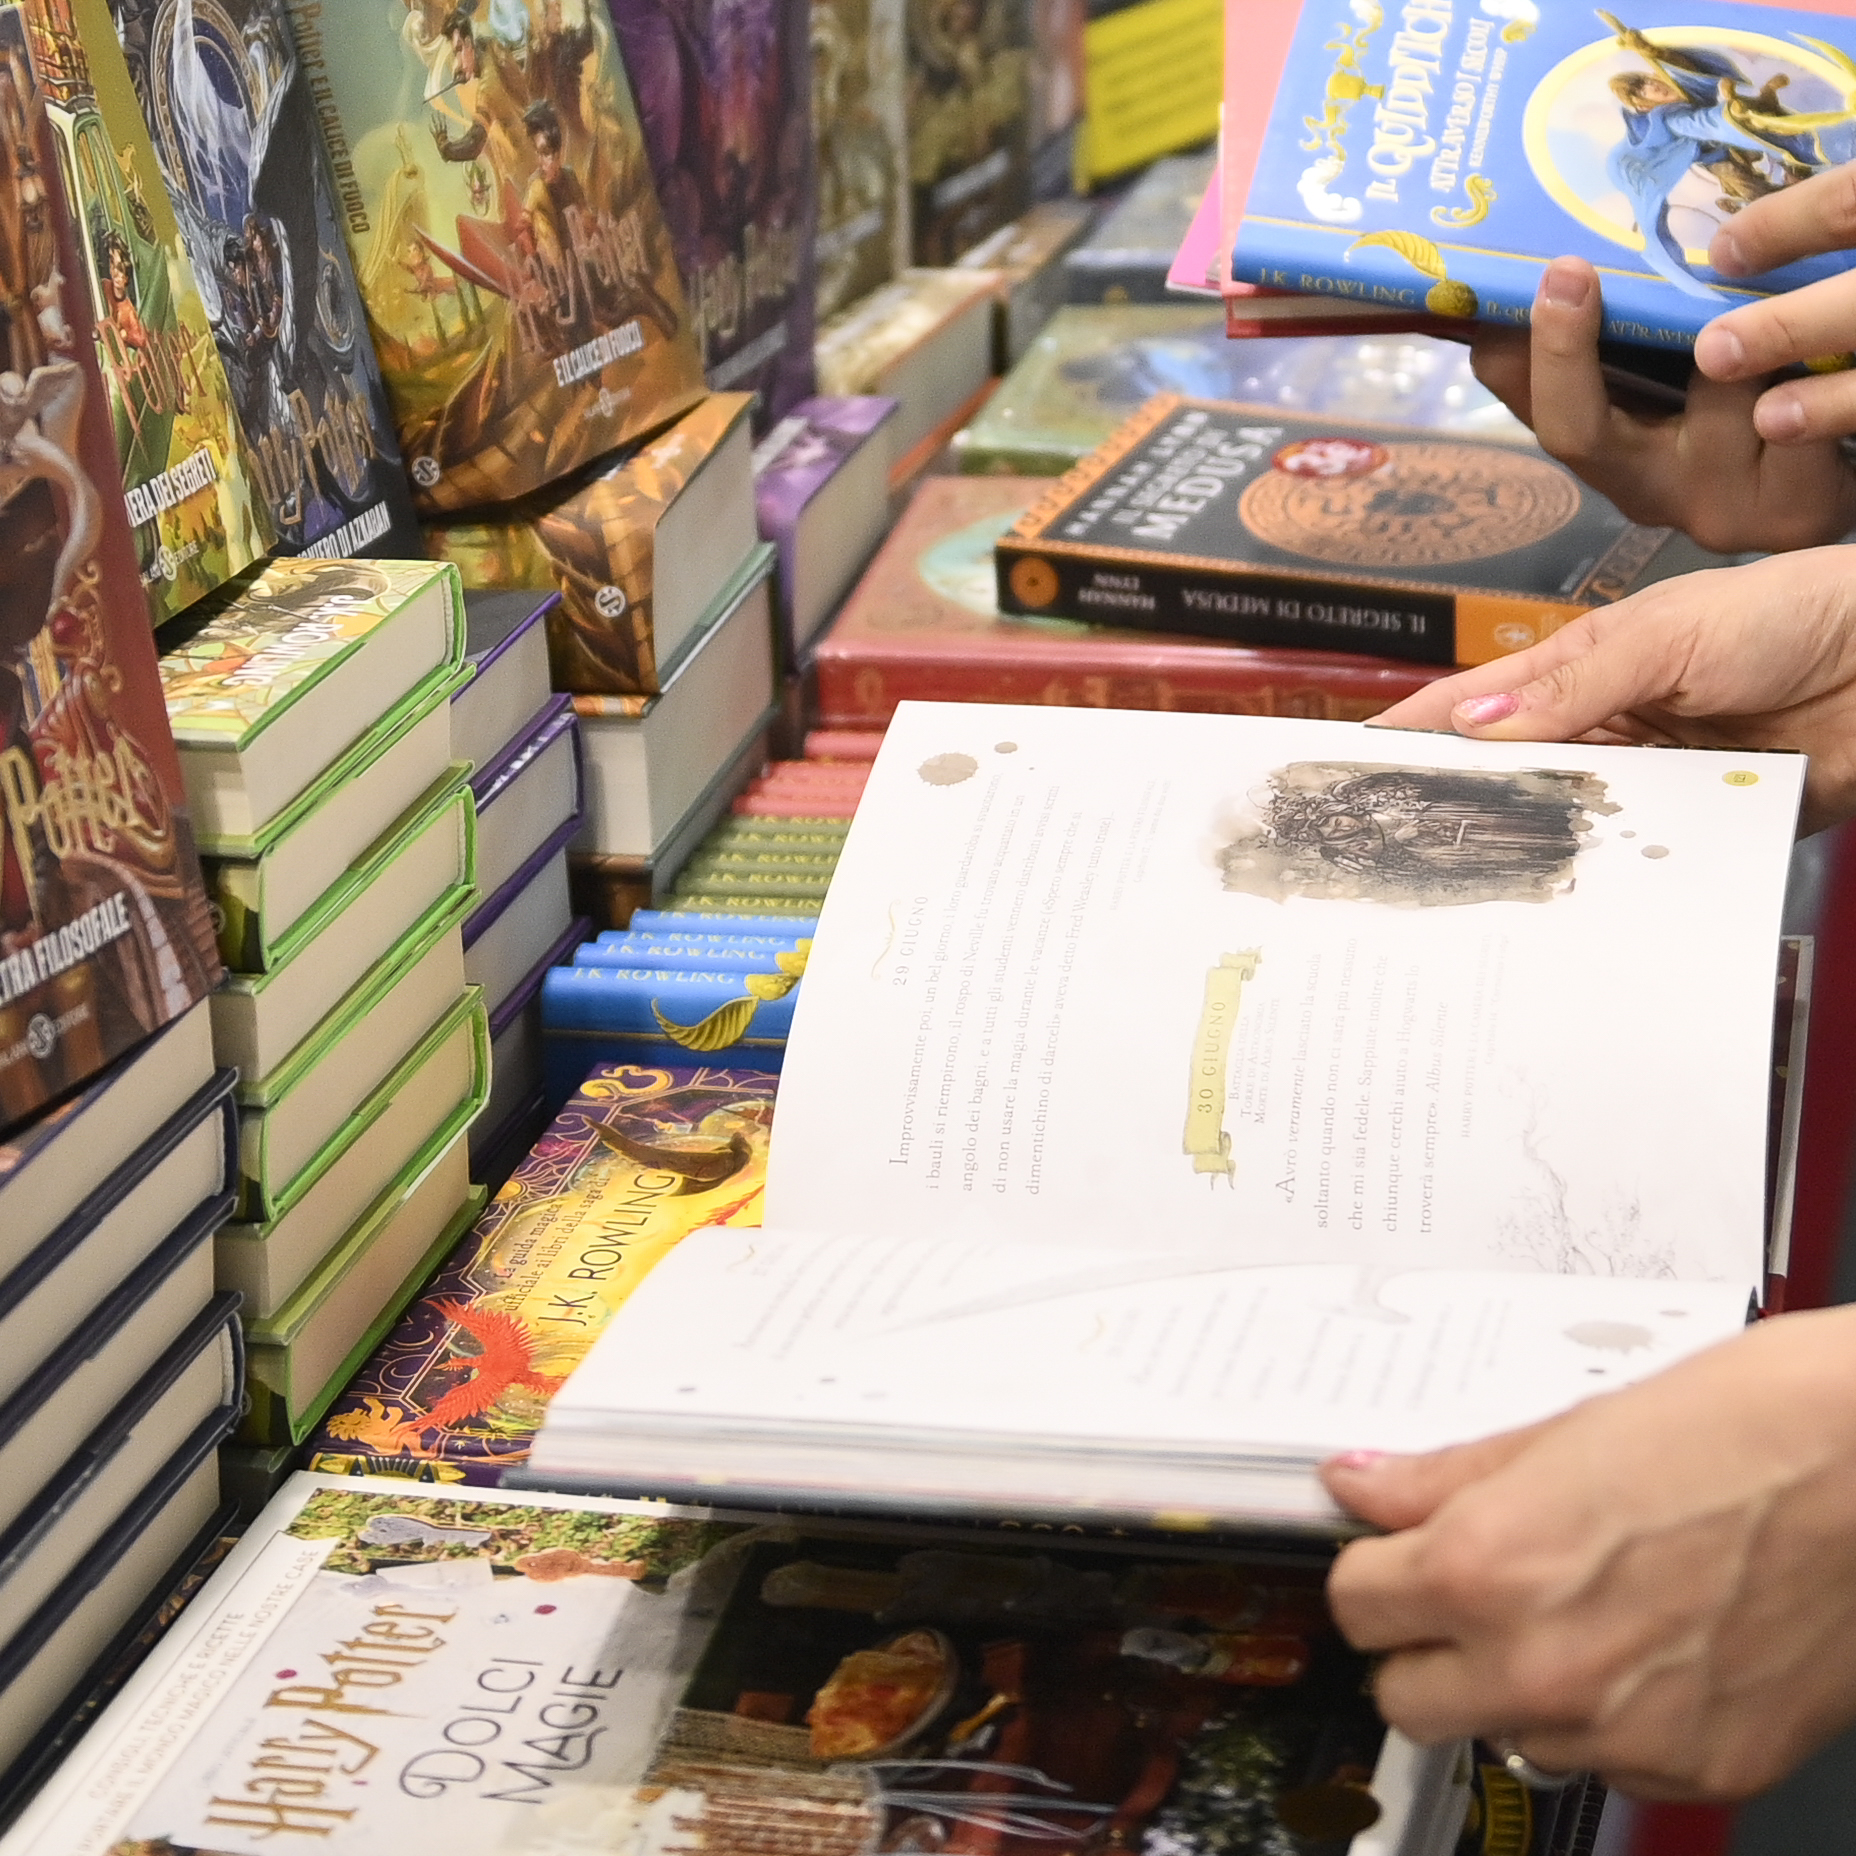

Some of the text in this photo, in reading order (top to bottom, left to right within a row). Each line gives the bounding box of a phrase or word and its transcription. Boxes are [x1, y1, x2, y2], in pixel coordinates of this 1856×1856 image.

[286, 2, 325, 70] Potter
[318, 105, 348, 160] CALICE
[1429, 16, 1495, 193] ATTRAVERSO SECOLI
[334, 162, 353, 180] DI
[342, 181, 372, 234] FUOCO
[1299, 273, 1415, 305] ROWLING
[149, 470, 176, 517] DEI
[168, 447, 218, 506] SEGRETI
[1128, 424, 1285, 540] MEDUSA
[348, 500, 392, 553] AZKABAN
[1180, 587, 1427, 635] IL SEGRETO DI MEDUSA
[220, 621, 346, 687] ROWLING
[31, 892, 134, 983] FILOSOFALE
[647, 944, 766, 960] ROWLING
[891, 895, 929, 987] 29 GIUGNO
[616, 968, 735, 984] ROWLING
[1298, 994, 1316, 1007] la
[1195, 1000, 1227, 1114] 30 GIUGNO
[1290, 1008, 1313, 1062] lasciato
[1329, 1046, 1342, 1060] ci
[1330, 1014, 1346, 1044] sarà
[1356, 1025, 1379, 1087] Sappiate
[1398, 1046, 1410, 1056] a
[887, 1005, 935, 1165] Improvvisamente poi,
[1326, 1062, 1340, 1093] non
[1393, 1057, 1408, 1097] aiuto
[1424, 1051, 1443, 1094] Albus
[960, 1060, 990, 1193] angolo dei bagni,
[1024, 1012, 1062, 1196] dimentichino di darceli»
[1287, 1064, 1306, 1143] veramente
[1319, 1095, 1337, 1157] quando
[1351, 1090, 1371, 1142] fedele.
[1386, 1100, 1405, 1150] cerchi
[1423, 1097, 1441, 1169] sempre».
[1274, 1148, 1298, 1204] «Avrò
[1349, 1173, 1365, 1196] mi
[1354, 1145, 1367, 1169] sia
[1312, 1159, 1331, 1229] soltanto
[1346, 1200, 1364, 1231] che
[1380, 1153, 1404, 1233] chiunque
[1418, 1173, 1434, 1234] troverà
[499, 1198, 566, 1280] La guida magica
[504, 1175, 612, 1312] ufficiale ai libri della saga di
[536, 1172, 678, 1328] J.K. ROWLING
[282, 1548, 319, 1582] CASE
[203, 1602, 460, 1841] Harry Potter
[398, 1656, 545, 1800] DOLCI
[479, 1665, 625, 1805] MAGIE
